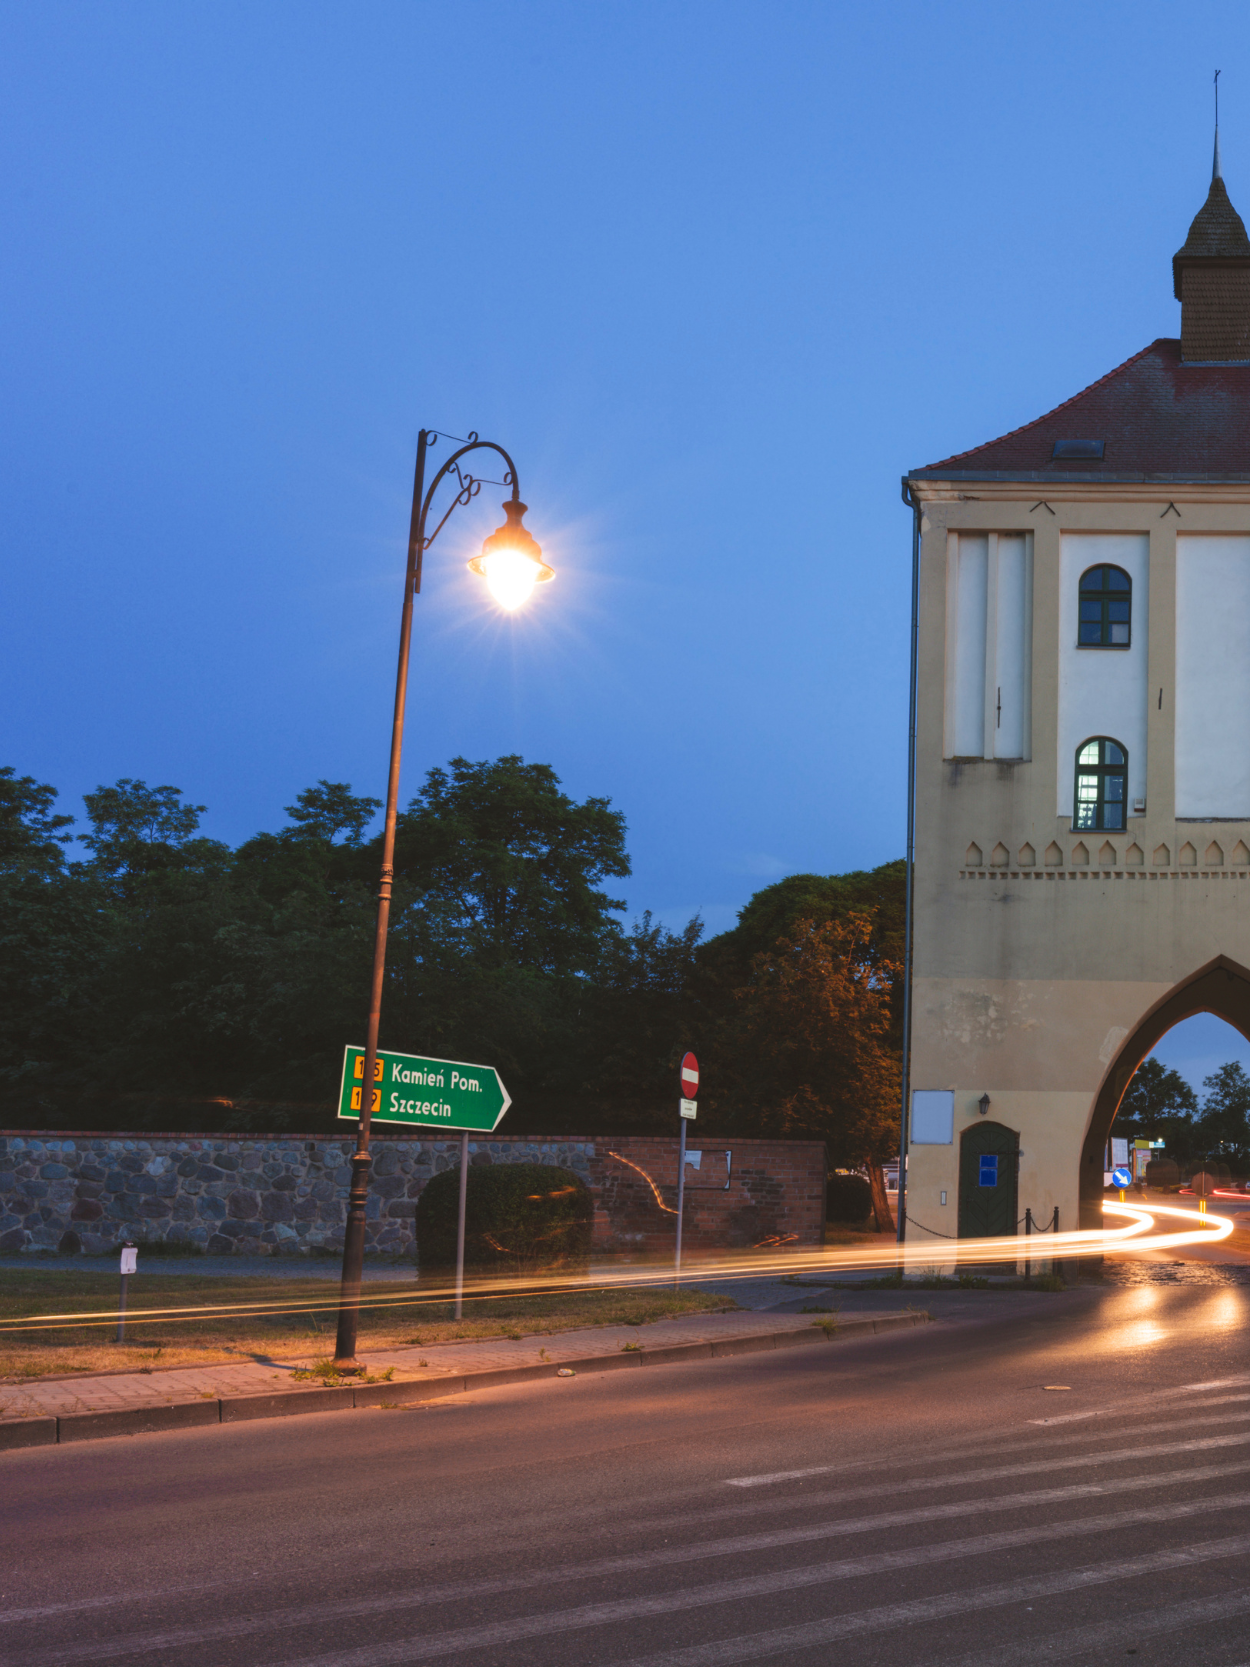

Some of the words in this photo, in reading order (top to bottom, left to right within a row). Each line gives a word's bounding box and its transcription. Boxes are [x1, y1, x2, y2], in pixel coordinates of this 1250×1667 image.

[359, 1059, 380, 1077] 15
[392, 1063, 444, 1087] Kamień
[451, 1071, 482, 1092] Pom.
[355, 1090, 378, 1107] 19
[389, 1092, 451, 1117] Szczecin
